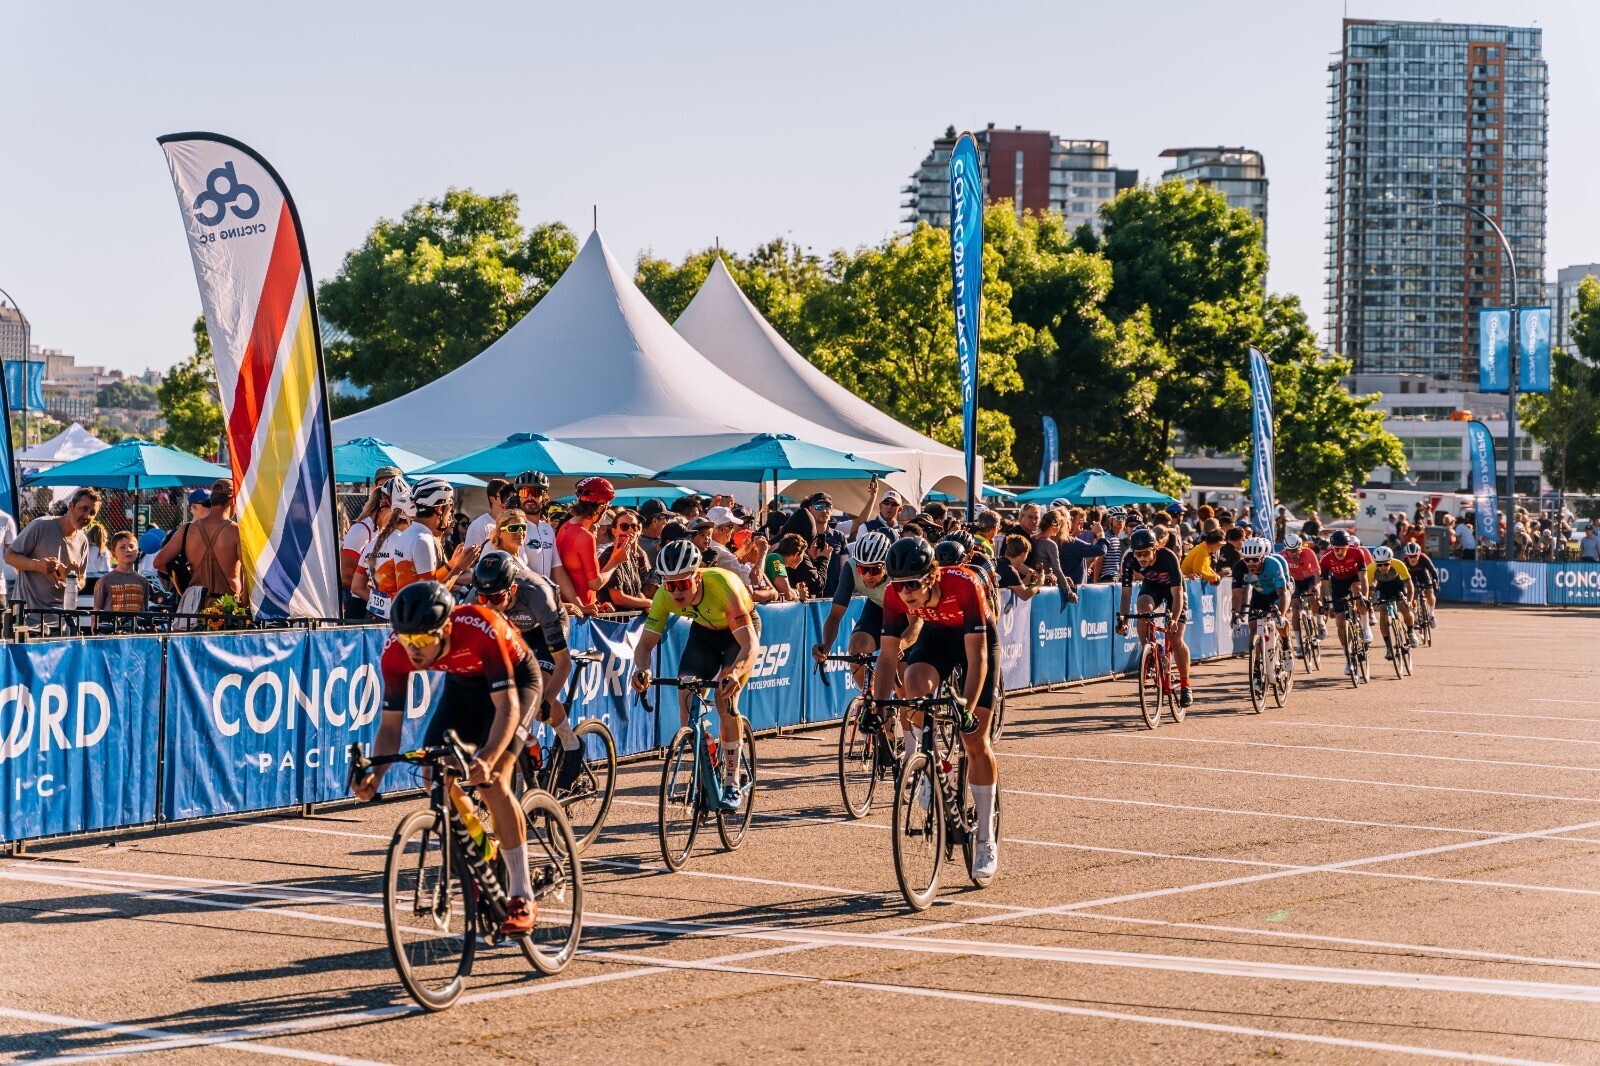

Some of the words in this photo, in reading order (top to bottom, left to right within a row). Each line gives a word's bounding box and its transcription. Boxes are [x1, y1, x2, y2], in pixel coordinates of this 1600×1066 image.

[956, 303, 972, 403] PACIFIC
[454, 615, 499, 640] MOSAIC
[749, 643, 791, 678] BSP
[259, 743, 370, 774] PACIFI
